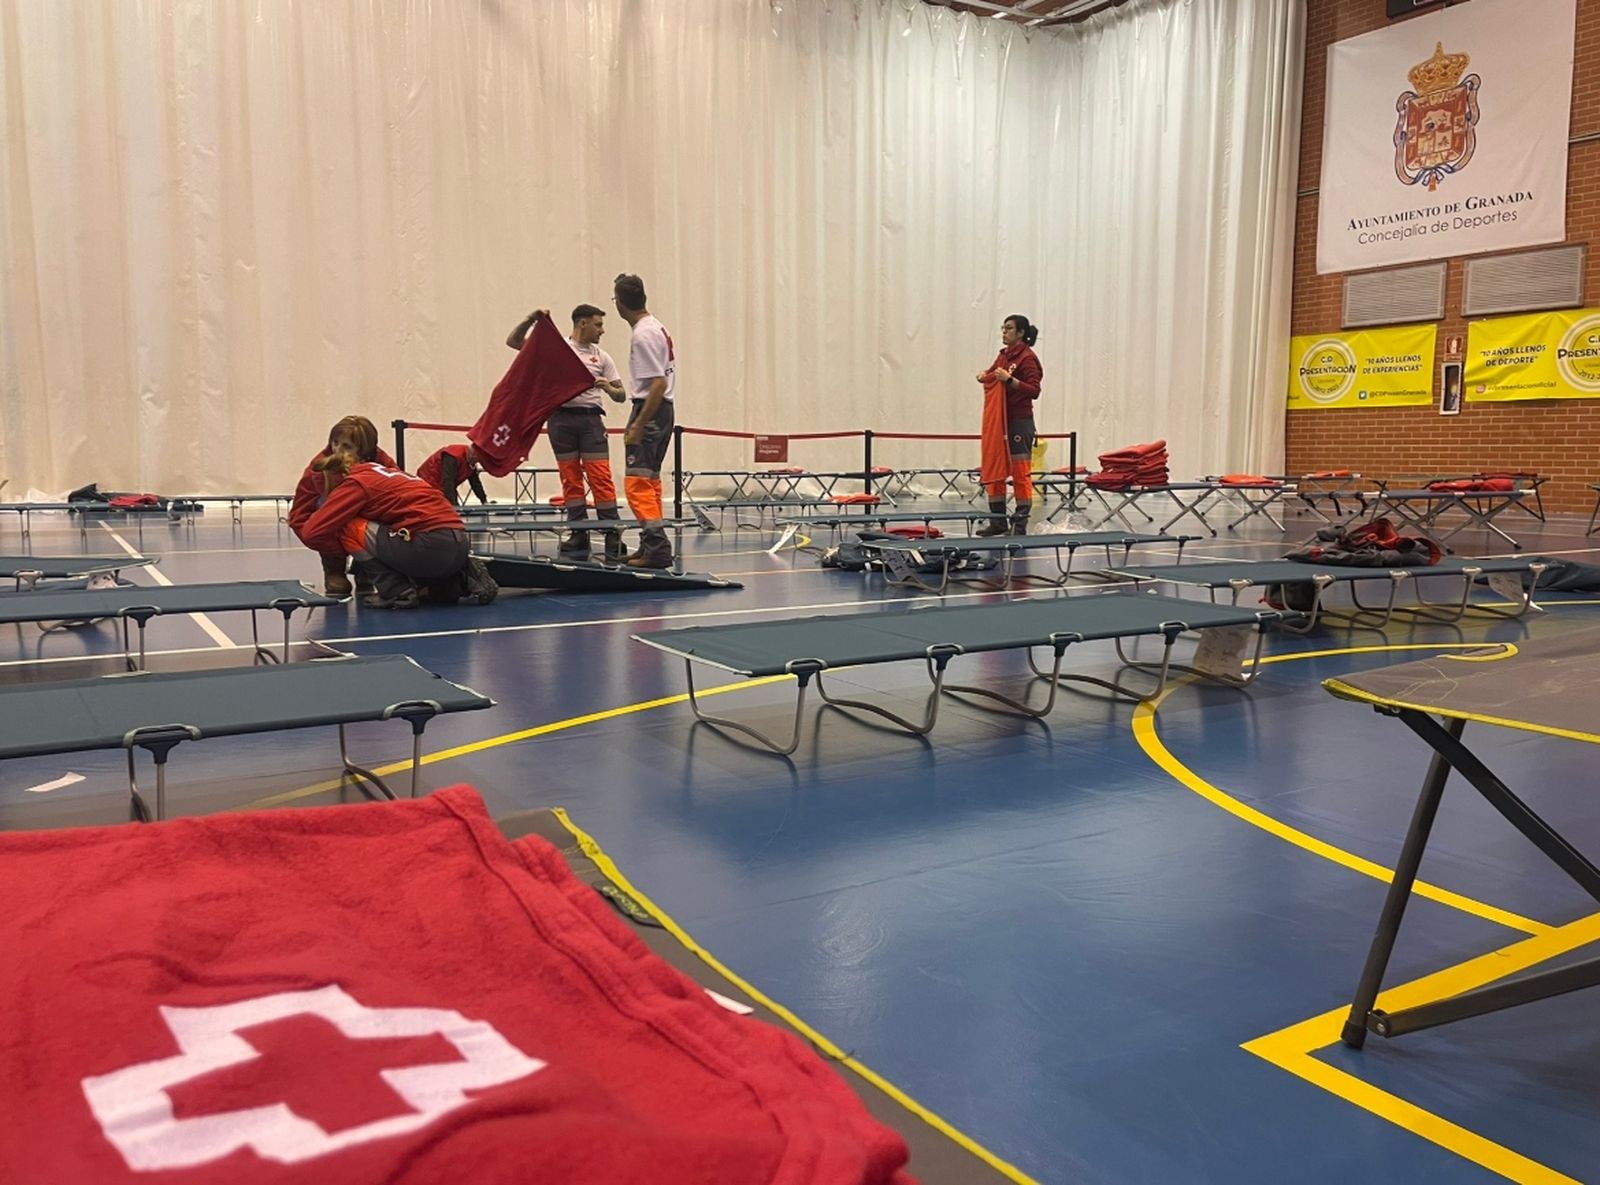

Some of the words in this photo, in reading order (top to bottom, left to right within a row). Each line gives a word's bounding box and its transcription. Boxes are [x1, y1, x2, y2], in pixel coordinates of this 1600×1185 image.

[1347, 206, 1441, 231] AYUNTAMIENTO
[1444, 202, 1461, 215] DE
[1465, 191, 1533, 210] GRANADA
[1358, 223, 1427, 244] Concejalía
[1431, 220, 1449, 234] de
[1453, 210, 1518, 230] Deportes
[1515, 344, 1546, 354] LLENOS
[1395, 354, 1422, 363] LLENOS
[1485, 359, 1497, 367] DE
[1363, 367, 1371, 375] DE
